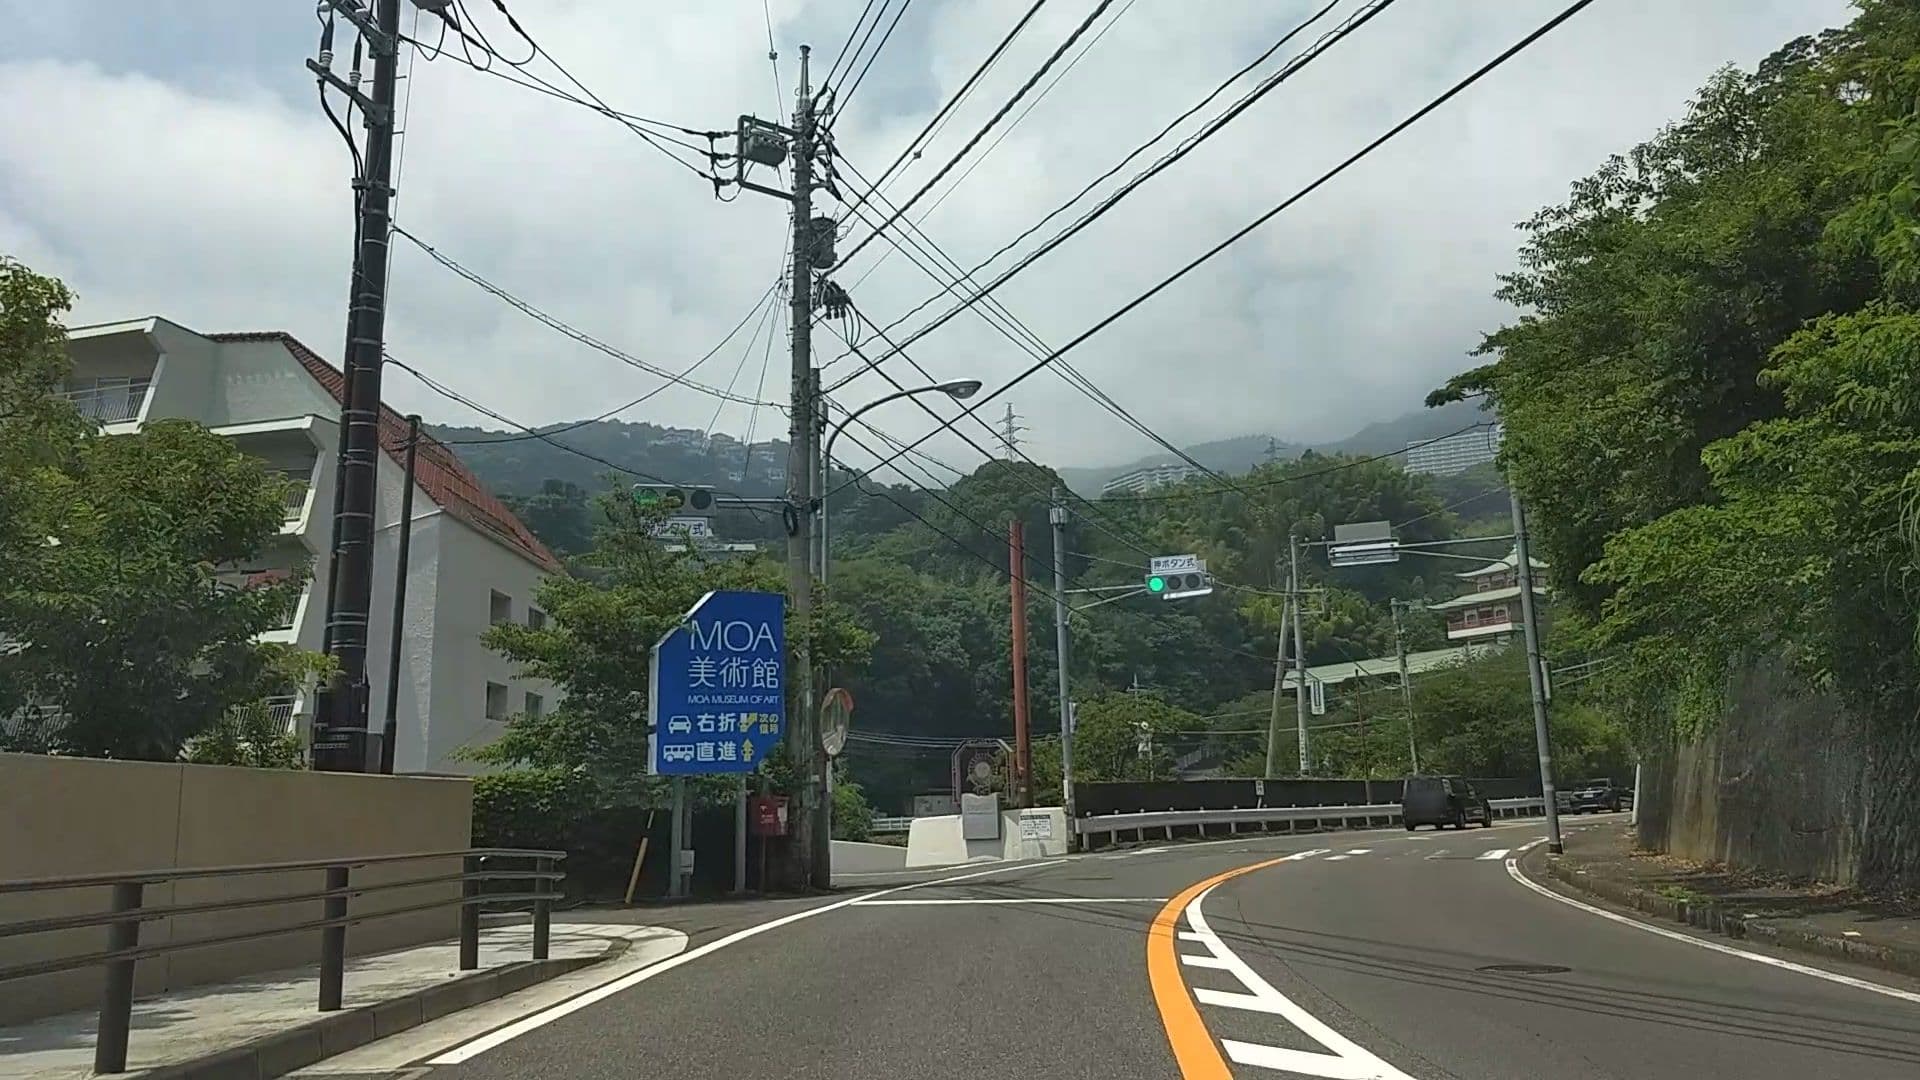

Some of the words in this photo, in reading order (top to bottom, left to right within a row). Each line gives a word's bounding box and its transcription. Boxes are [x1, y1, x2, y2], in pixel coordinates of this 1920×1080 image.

[1154, 558, 1195, 570] 押ボタン式
[690, 620, 778, 652] MOA
[688, 656, 780, 689] 美術館
[688, 695, 709, 704] MOA
[712, 695, 749, 704] MUSEUM
[750, 695, 762, 704] OF
[762, 695, 780, 704] ART
[697, 713, 736, 733] 右折
[759, 713, 779, 723] 次の
[696, 741, 737, 762] 直進
